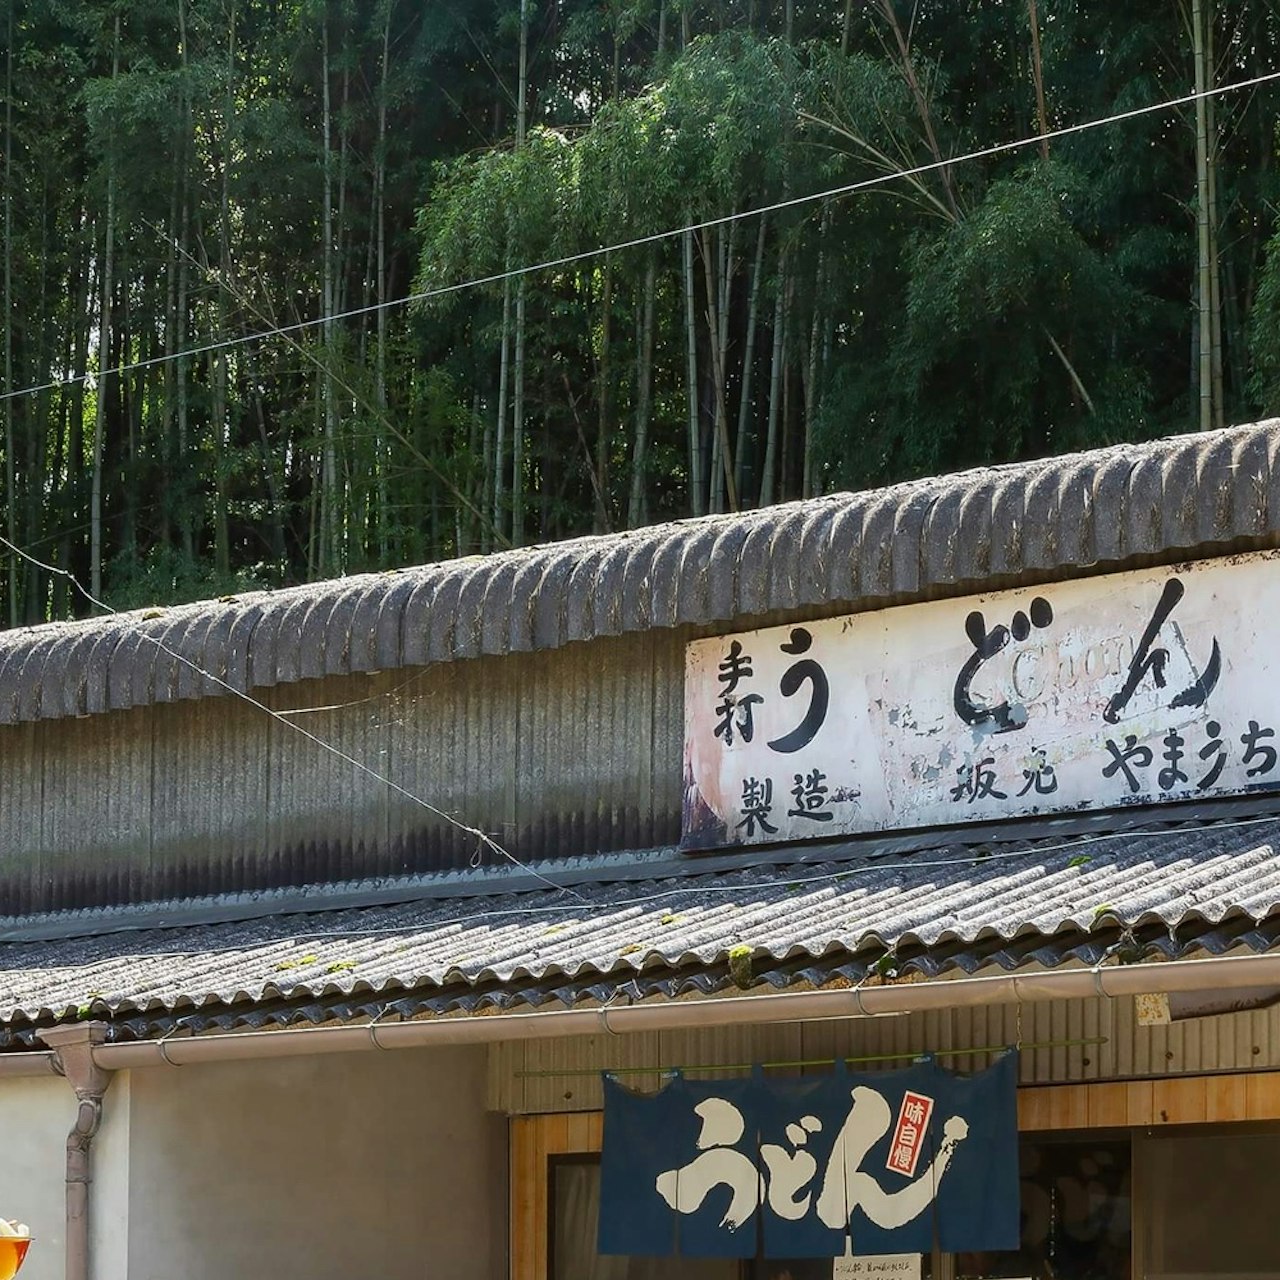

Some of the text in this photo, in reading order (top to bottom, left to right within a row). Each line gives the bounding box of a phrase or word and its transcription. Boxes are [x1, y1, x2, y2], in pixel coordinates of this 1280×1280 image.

[714, 640, 764, 746] 手打
[1102, 720, 1277, 792] やまうち
[735, 768, 834, 836] 製造
[656, 1086, 969, 1234] うどん
[894, 1101, 925, 1170] 味自慢
